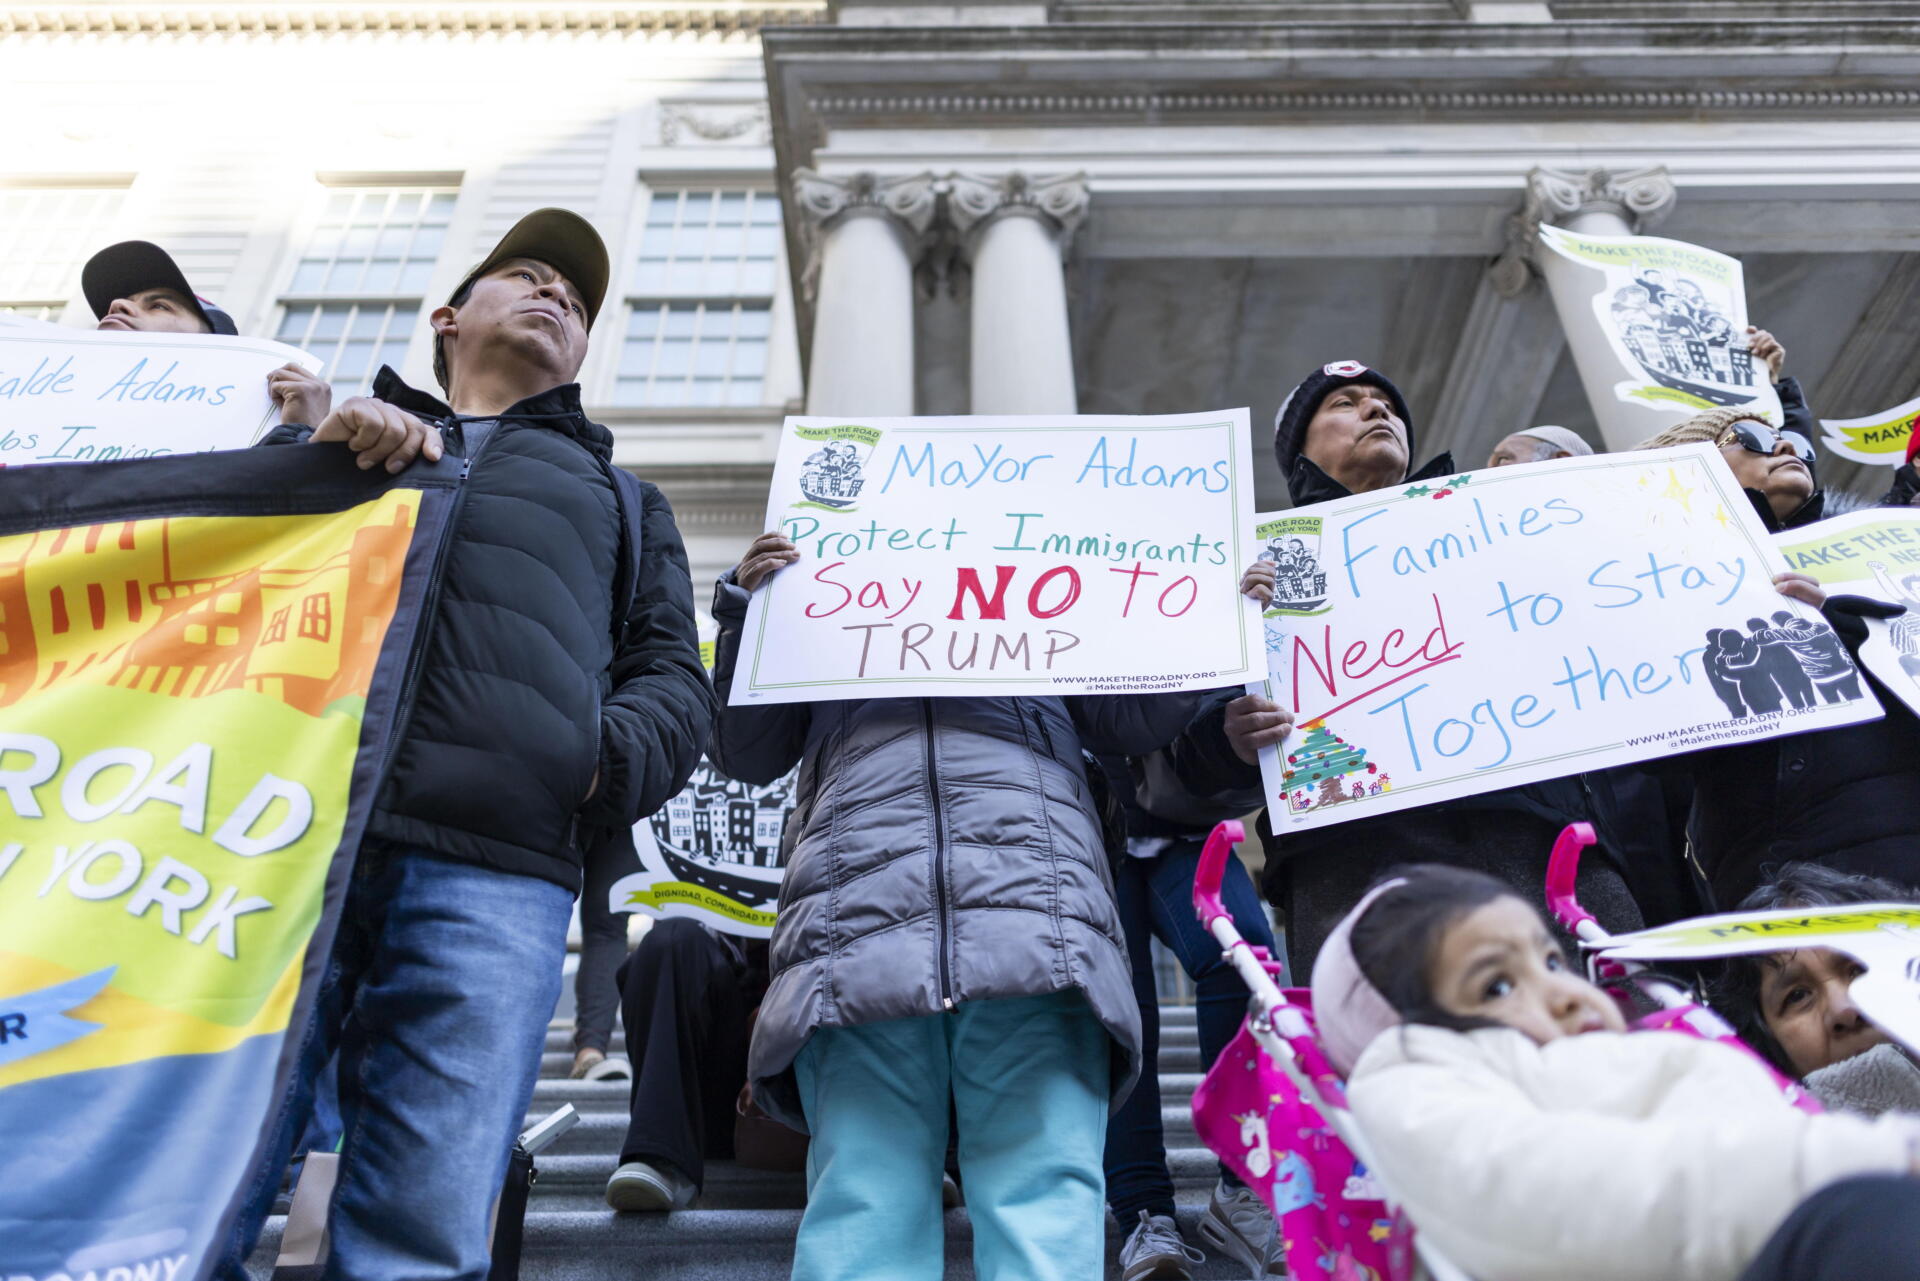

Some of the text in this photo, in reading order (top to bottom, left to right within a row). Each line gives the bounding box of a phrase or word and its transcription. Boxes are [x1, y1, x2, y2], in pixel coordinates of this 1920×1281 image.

[1579, 243, 1729, 274] MAKE THE ROAD
[0, 355, 236, 406] alde Adams
[832, 426, 852, 434] THE
[852, 427, 880, 438] ROAD
[1076, 436, 1229, 493] Adams
[783, 513, 1228, 566] Protect Immigrants
[1269, 520, 1288, 531] THE
[1342, 497, 1584, 598] Families
[1850, 527, 1916, 551] THE
[804, 561, 1199, 621] Say NO TO
[1487, 552, 1746, 633] to Stay
[842, 622, 1081, 679] TRUMP
[1293, 593, 1465, 713] Need
[1053, 671, 1217, 684] WWW.MAKETHEROADNY.ORG
[1085, 681, 1184, 691] @MaketheRoadNY
[1367, 645, 1708, 772] Together
[1625, 705, 1817, 747] WWW.MAKETHEROADNY.ORG
[1670, 721, 1782, 750] @MaketheRoadNY
[0, 732, 313, 857] ROAD
[37, 839, 273, 959] YORK
[654, 889, 703, 902] DIGNIDAD,
[704, 896, 759, 921] COMUNIDAD
[1710, 917, 1864, 938] MAKE
